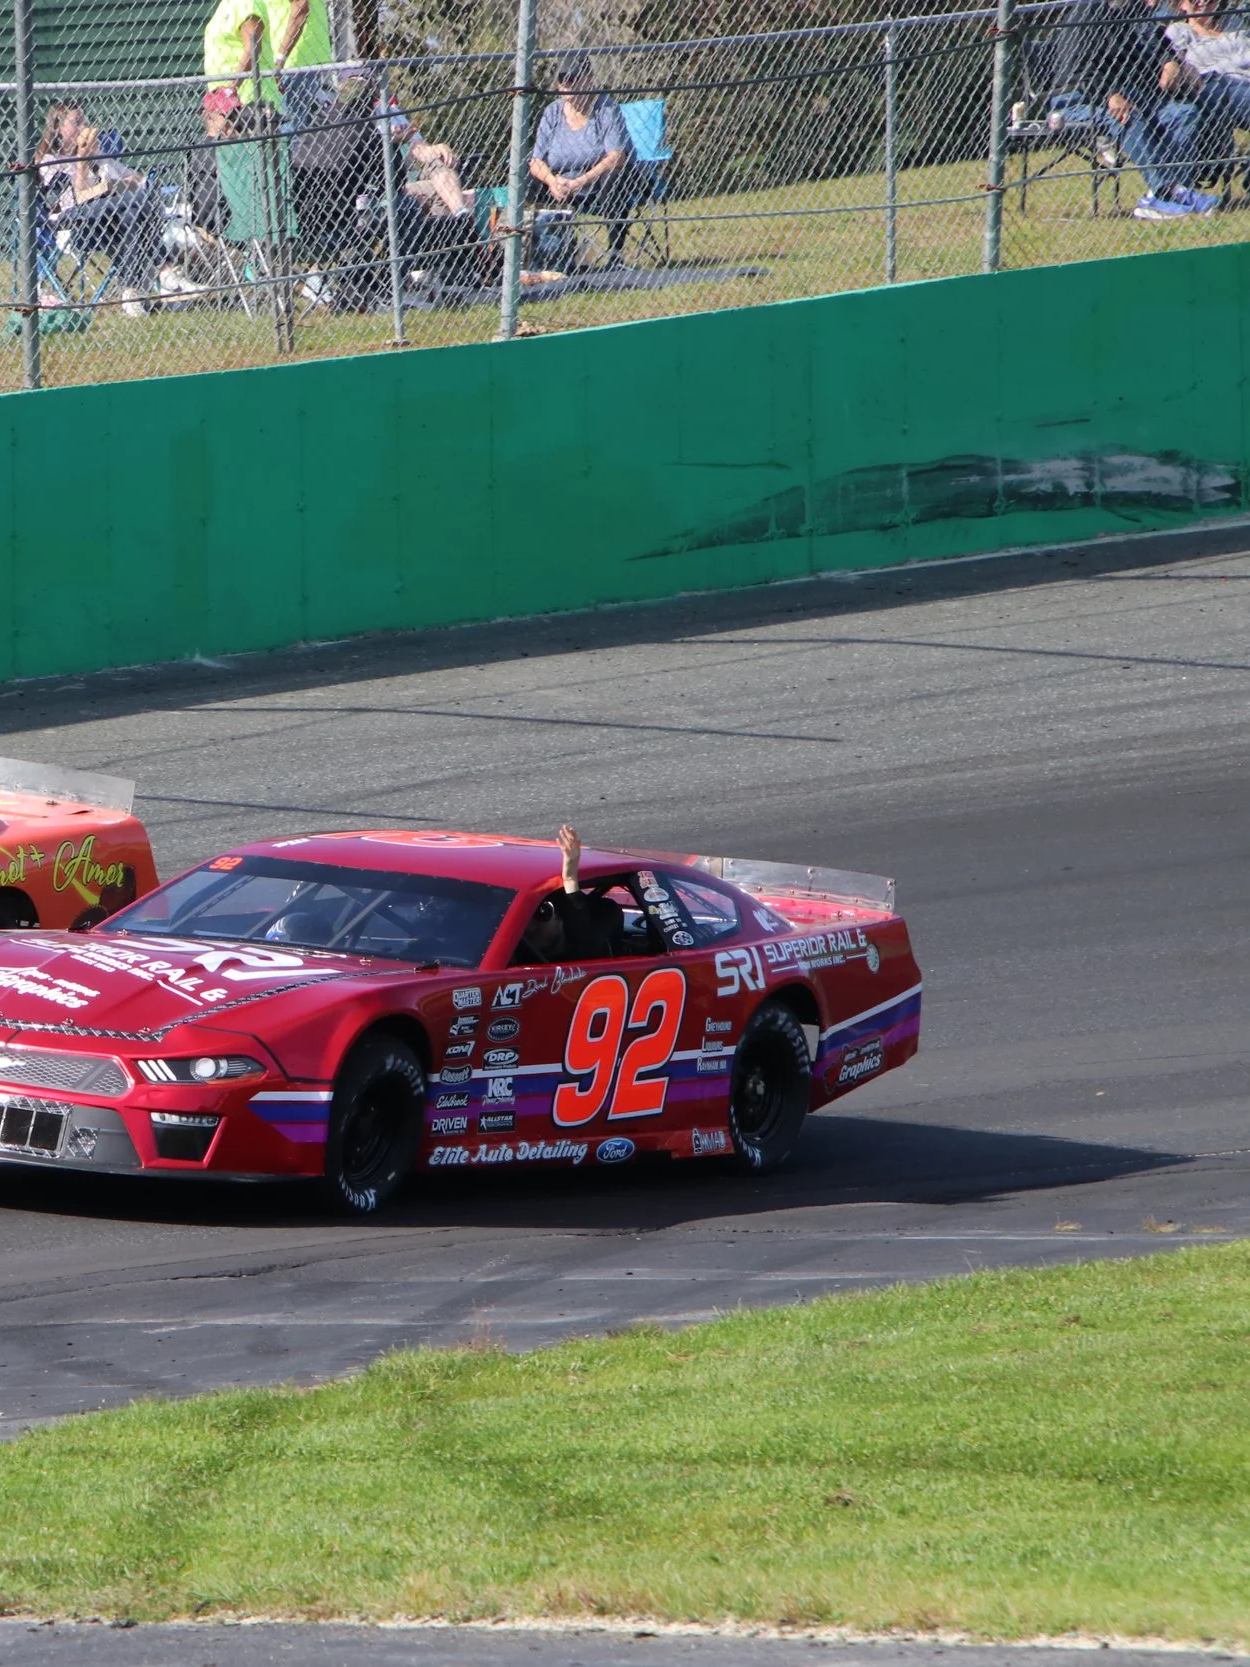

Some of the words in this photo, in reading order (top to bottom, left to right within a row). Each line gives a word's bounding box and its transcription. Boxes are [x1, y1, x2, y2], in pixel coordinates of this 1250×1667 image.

[52, 835, 125, 893] Amor
[208, 856, 245, 871] 92
[763, 934, 826, 963] SUPERIOR
[828, 929, 856, 952] RAIL
[856, 928, 868, 947] &
[715, 946, 766, 997] SRI
[811, 957, 833, 969] WORKS
[142, 961, 204, 991] RAIL
[200, 988, 229, 1002] &
[491, 982, 524, 1007] ACT
[488, 1052, 515, 1062] DRP
[552, 967, 687, 1128] 92
[838, 1053, 882, 1081] Graphics
[488, 1077, 514, 1098] KRC
[436, 1093, 469, 1109] Edelbrock
[431, 1116, 468, 1135] DRIVEN
[429, 1146, 471, 1166] Elite
[471, 1143, 513, 1164] Auto
[516, 1139, 589, 1165] Detailing
[602, 1141, 628, 1159] Ford
